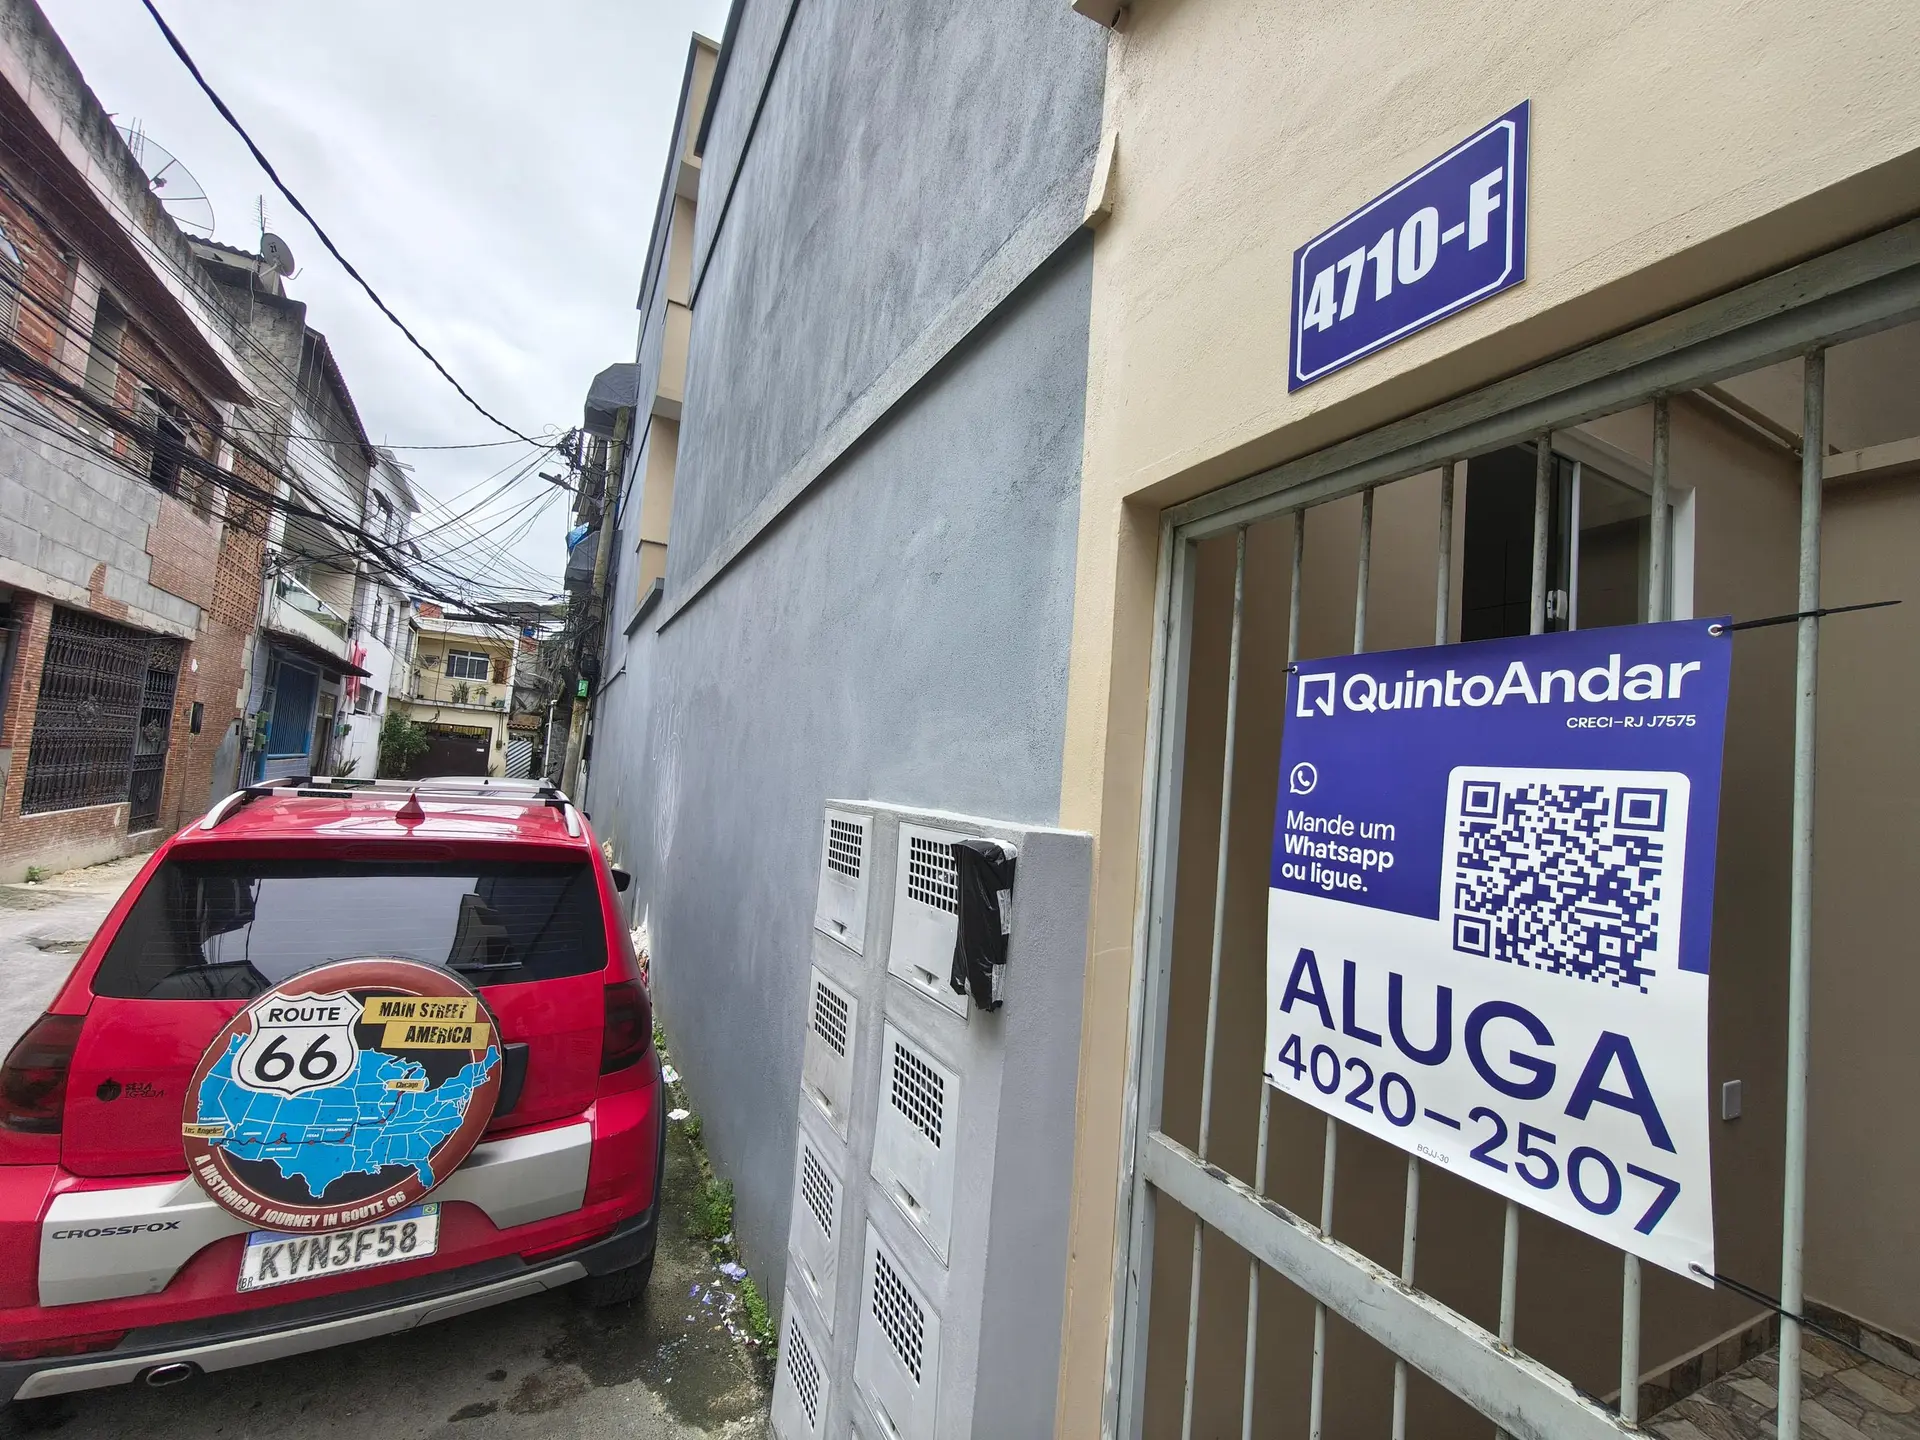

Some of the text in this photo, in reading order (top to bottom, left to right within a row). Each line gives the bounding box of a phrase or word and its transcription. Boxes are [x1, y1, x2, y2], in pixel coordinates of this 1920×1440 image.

[1303, 166, 1503, 333] 4710-F
[1343, 653, 1701, 714] QuintoAndar
[1566, 714, 1697, 729] CRECI-RJ J7575
[1286, 809, 1396, 841] Mande um
[1284, 833, 1395, 873] Whatsapp
[1281, 861, 1368, 892] ou ligue.
[268, 1006, 341, 1023] ROUTE
[378, 1001, 467, 1019] MAIN STREET
[404, 1025, 473, 1044] AMERICA
[254, 1033, 338, 1083] 66
[1279, 947, 1677, 1155] ALUGA
[1278, 1033, 1681, 1236] 4020-2507
[1416, 1143, 1450, 1164] BGJJ-30
[194, 1154, 407, 1228] A HISTORICAL JOURNEY IN ROUTE 66
[52, 1220, 181, 1240] CROSSFOX
[258, 1221, 418, 1282] KYN3F58
[241, 1275, 254, 1288] BR
